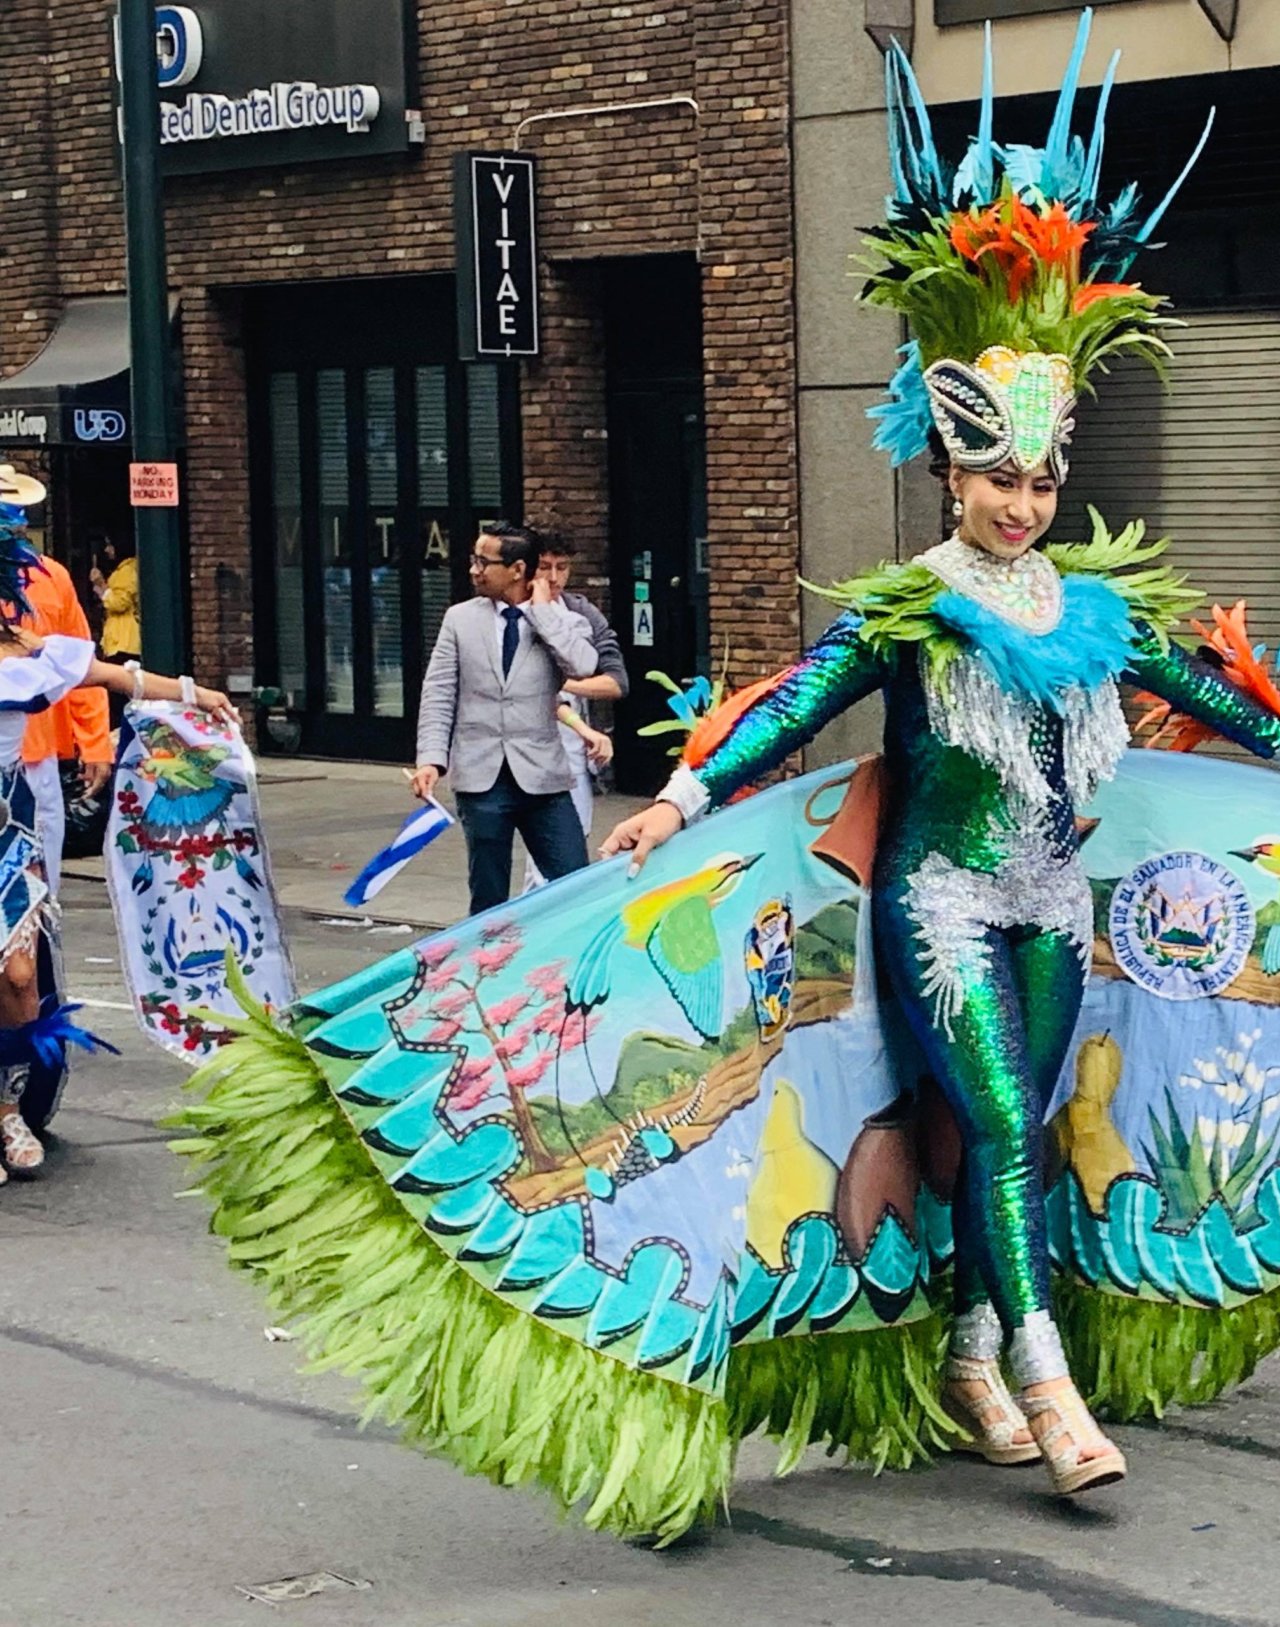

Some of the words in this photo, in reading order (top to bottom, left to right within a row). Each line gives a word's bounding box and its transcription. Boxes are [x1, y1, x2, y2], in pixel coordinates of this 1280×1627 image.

[160, 93, 194, 140] ted
[202, 87, 281, 134] Dental
[286, 83, 366, 131] Group
[491, 173, 519, 334] VITAE
[133, 489, 174, 499] MONDAY
[637, 608, 651, 633] A
[1132, 855, 1193, 887] SALVADOR
[1200, 858, 1218, 874] EN
[1219, 872, 1236, 888] LA
[1120, 888, 1135, 903] EL
[1113, 907, 1129, 924] DE
